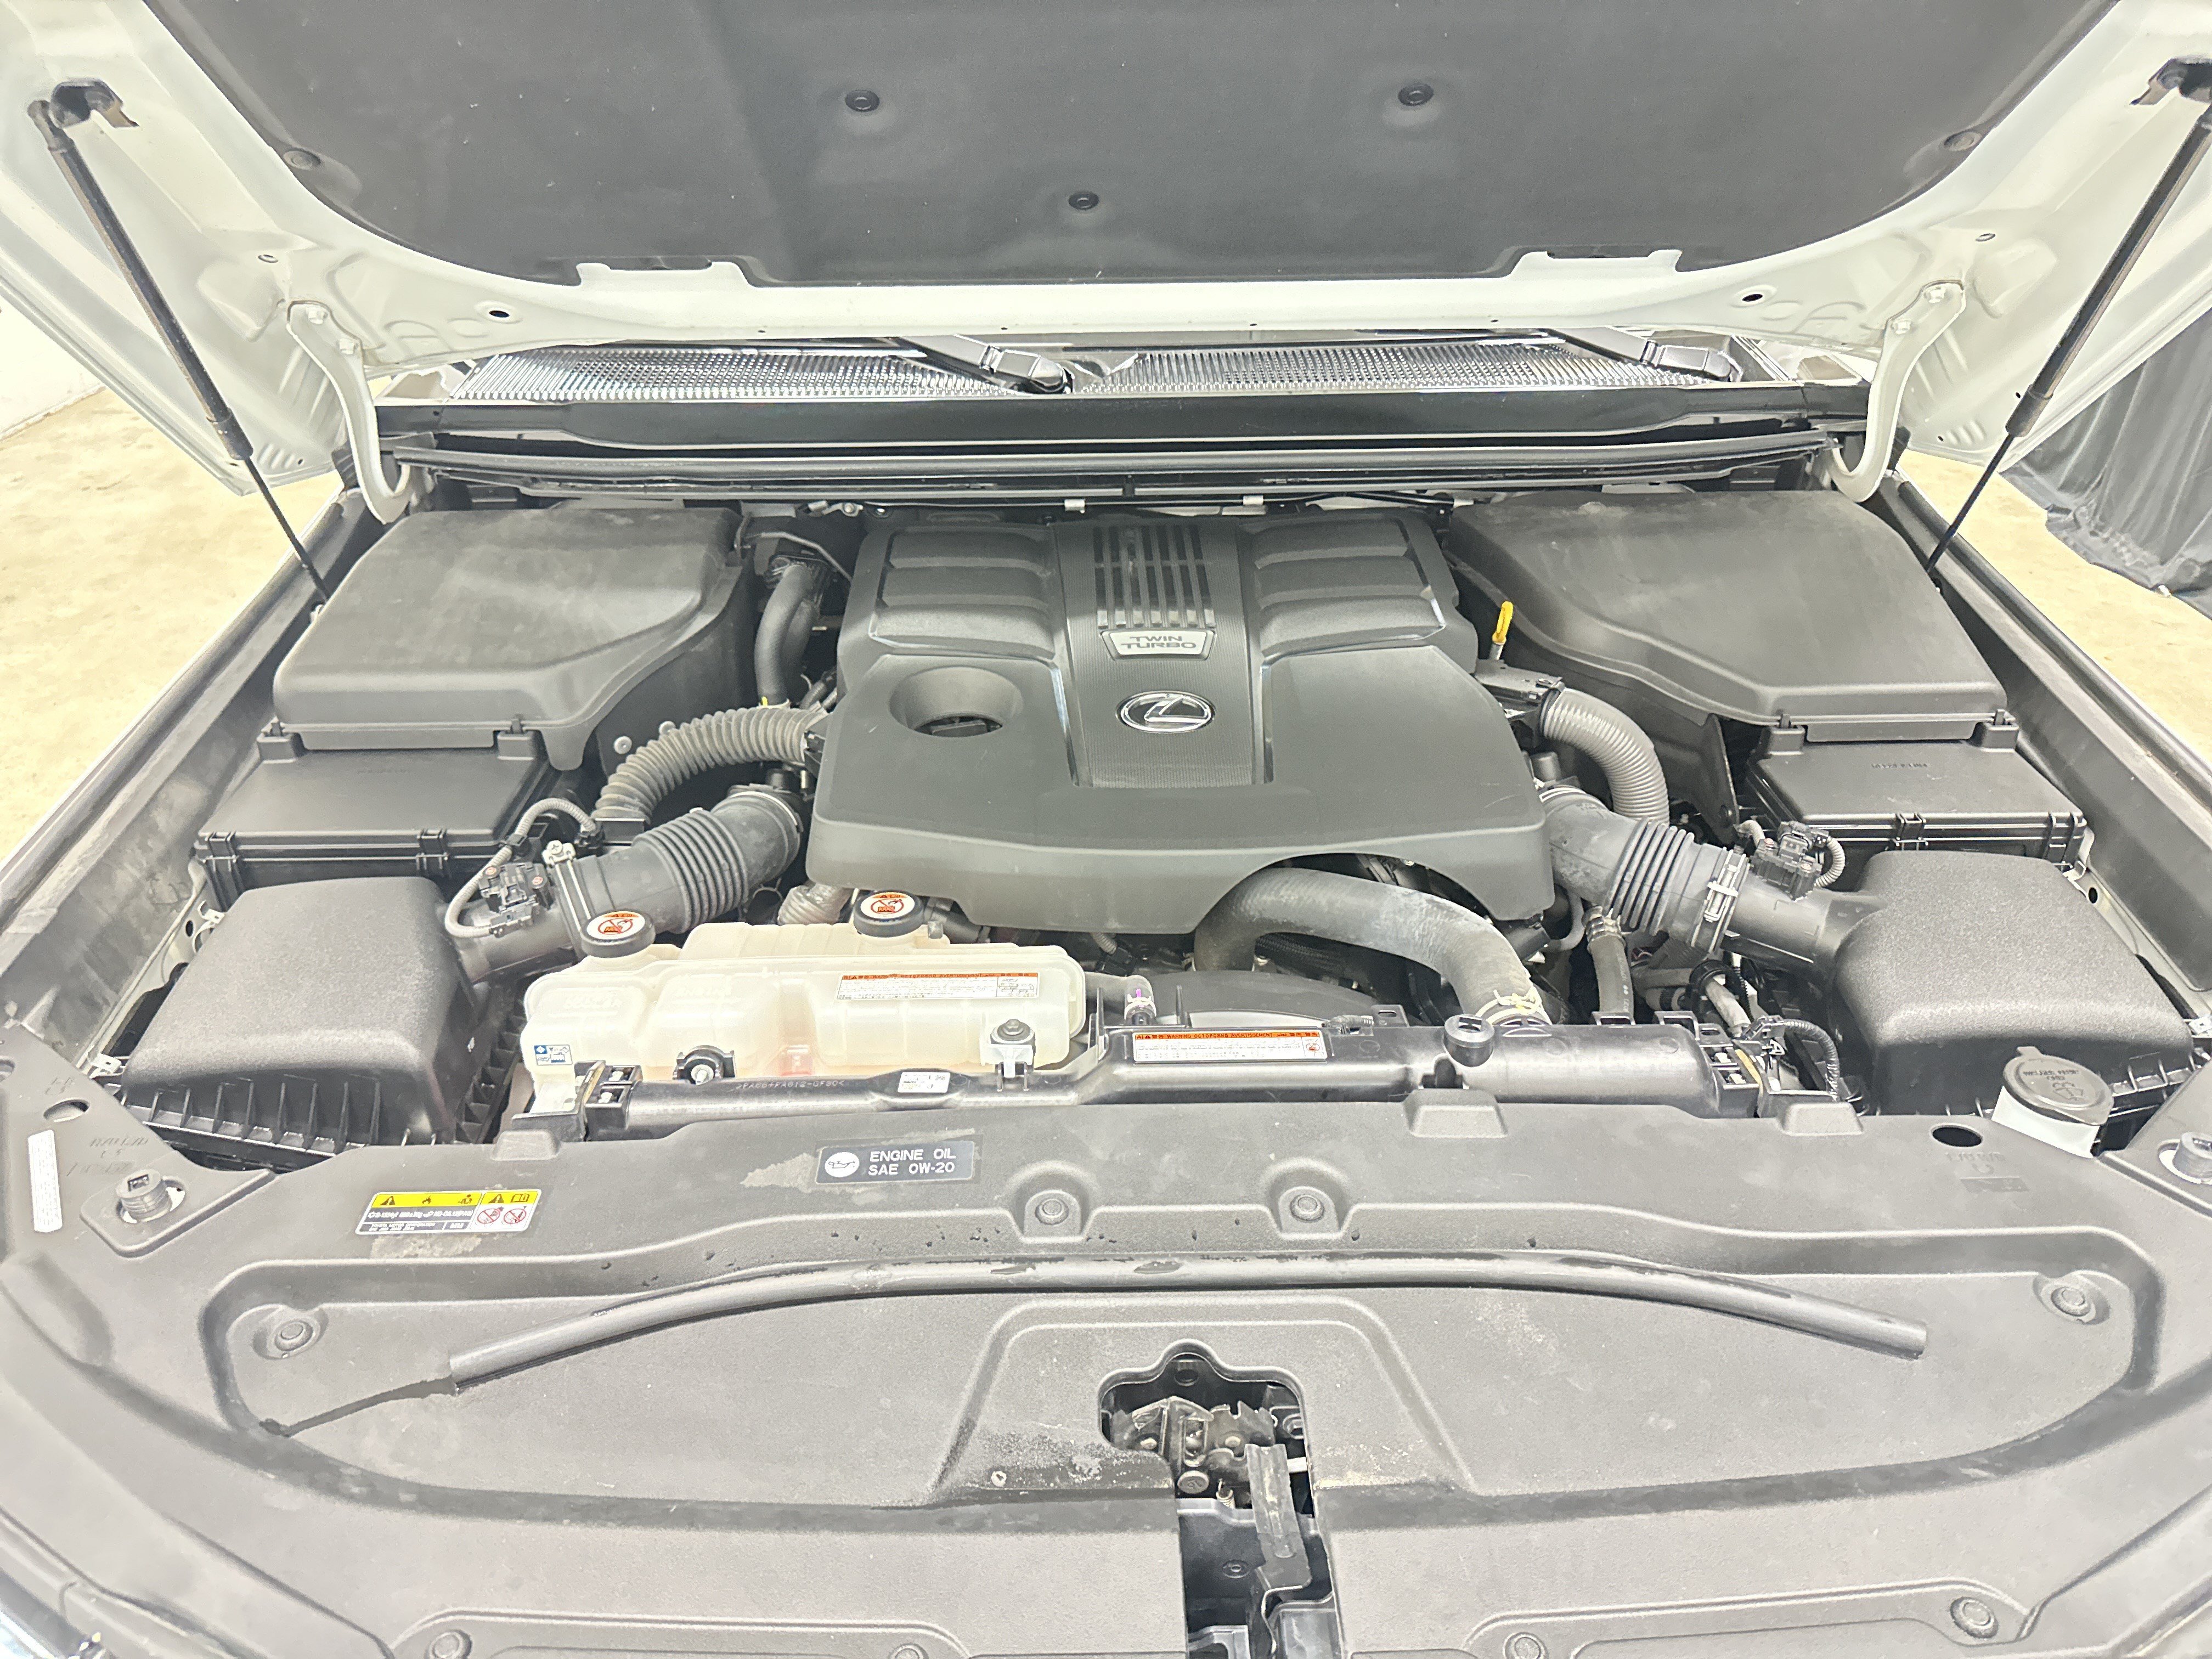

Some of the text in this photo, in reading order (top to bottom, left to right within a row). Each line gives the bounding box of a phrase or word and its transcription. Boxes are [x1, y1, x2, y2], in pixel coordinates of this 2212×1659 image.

[870, 1148, 956, 1162] ENGINE OIL
[868, 1161, 955, 1176] SAE 0W-20
